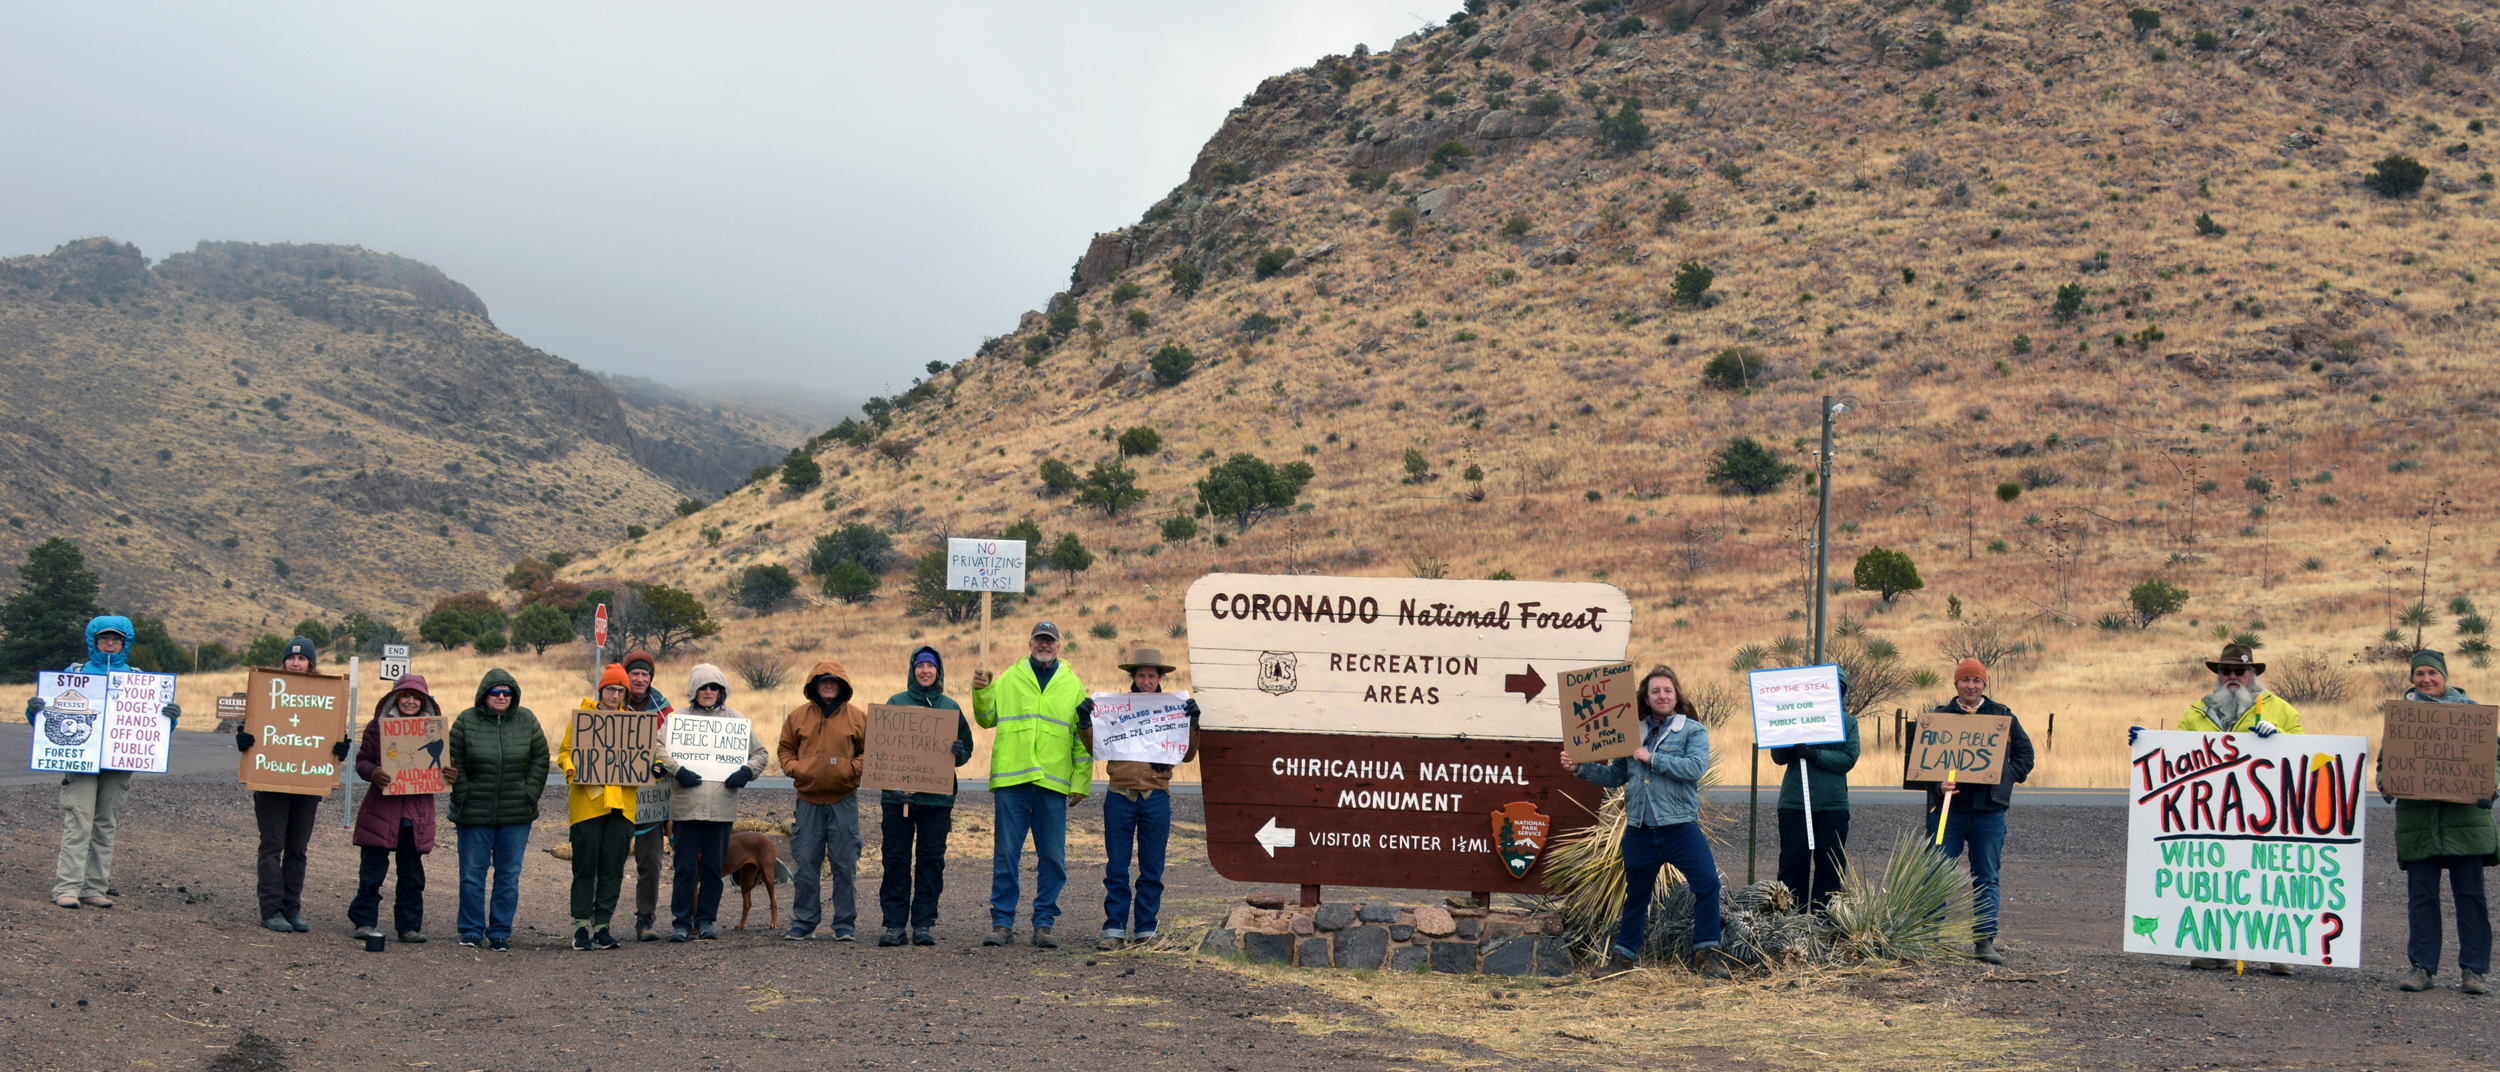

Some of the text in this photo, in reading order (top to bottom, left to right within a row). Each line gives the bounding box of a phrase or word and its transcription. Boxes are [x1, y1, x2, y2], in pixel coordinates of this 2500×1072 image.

[978, 543, 996, 555] NO
[953, 555, 1023, 568] PRIVATIZING
[964, 576, 1011, 589] PARKS!
[1211, 592, 1608, 633] CORONADO National Forest
[596, 617, 607, 633] STOP
[386, 664, 405, 676] 181
[1330, 653, 1478, 676] RECREATION
[1603, 665, 1632, 676] BUDGET
[57, 675, 89, 688] STOP
[127, 674, 155, 686] KEEP
[125, 688, 155, 700] YOUR
[1363, 685, 1440, 705] AREAS
[1581, 679, 1611, 698] CUT
[1760, 686, 1780, 694] STOP
[116, 701, 161, 714] DOGE-Y
[1777, 703, 1795, 711] SAVE
[117, 715, 157, 727] HANDS
[289, 713, 300, 727] +
[875, 708, 944, 735] PROTECT
[1769, 716, 1826, 727] PUBLIC LANDS
[2390, 706, 2494, 726] PUBLIC LANDS
[384, 721, 401, 736] NO
[576, 713, 657, 750] PROTECT
[673, 718, 747, 735] DEFEND OUR
[1599, 729, 1616, 738] FROM
[2389, 724, 2486, 743] BELONG TO THE
[111, 728, 160, 742] OFF OUR
[671, 732, 747, 750] PUBLIC LANDS!
[1592, 733, 1625, 752] NATURE!
[1920, 730, 1999, 747] FUND PUBLIC
[114, 742, 155, 755] PUBLIC
[875, 733, 949, 753] OUR PARKS
[45, 748, 85, 758] FOREST
[672, 752, 744, 763] PROTECT PARKS!
[876, 751, 916, 763] NO CUTS
[2414, 742, 2470, 760] PEOPLE
[38, 759, 93, 771] FIRINGS!!
[112, 756, 154, 769] LANDS!
[571, 749, 650, 783] OUR PARKS
[1920, 748, 1993, 772] LANDS
[2133, 734, 2240, 791] Thanks
[2388, 756, 2489, 779] OUR PARKS ARE
[396, 768, 441, 782] ALLOWED
[875, 762, 934, 774] NO CLOSURES
[1272, 757, 1530, 786] CHIRICAHUA NATIONAL
[873, 772, 948, 786] NO COMPROMISES
[2390, 776, 2489, 795] NOT FOR SALE
[389, 780, 445, 795] ON TRAILS
[2161, 752, 2365, 836] KRASNOV
[1337, 789, 1463, 812] MONUMENT
[1309, 831, 1371, 848] VISITOR
[1379, 834, 1441, 851] CENTER
[2161, 840, 2340, 877] WHO NEEDS
[2155, 868, 2346, 910] PUBLIC LANDS
